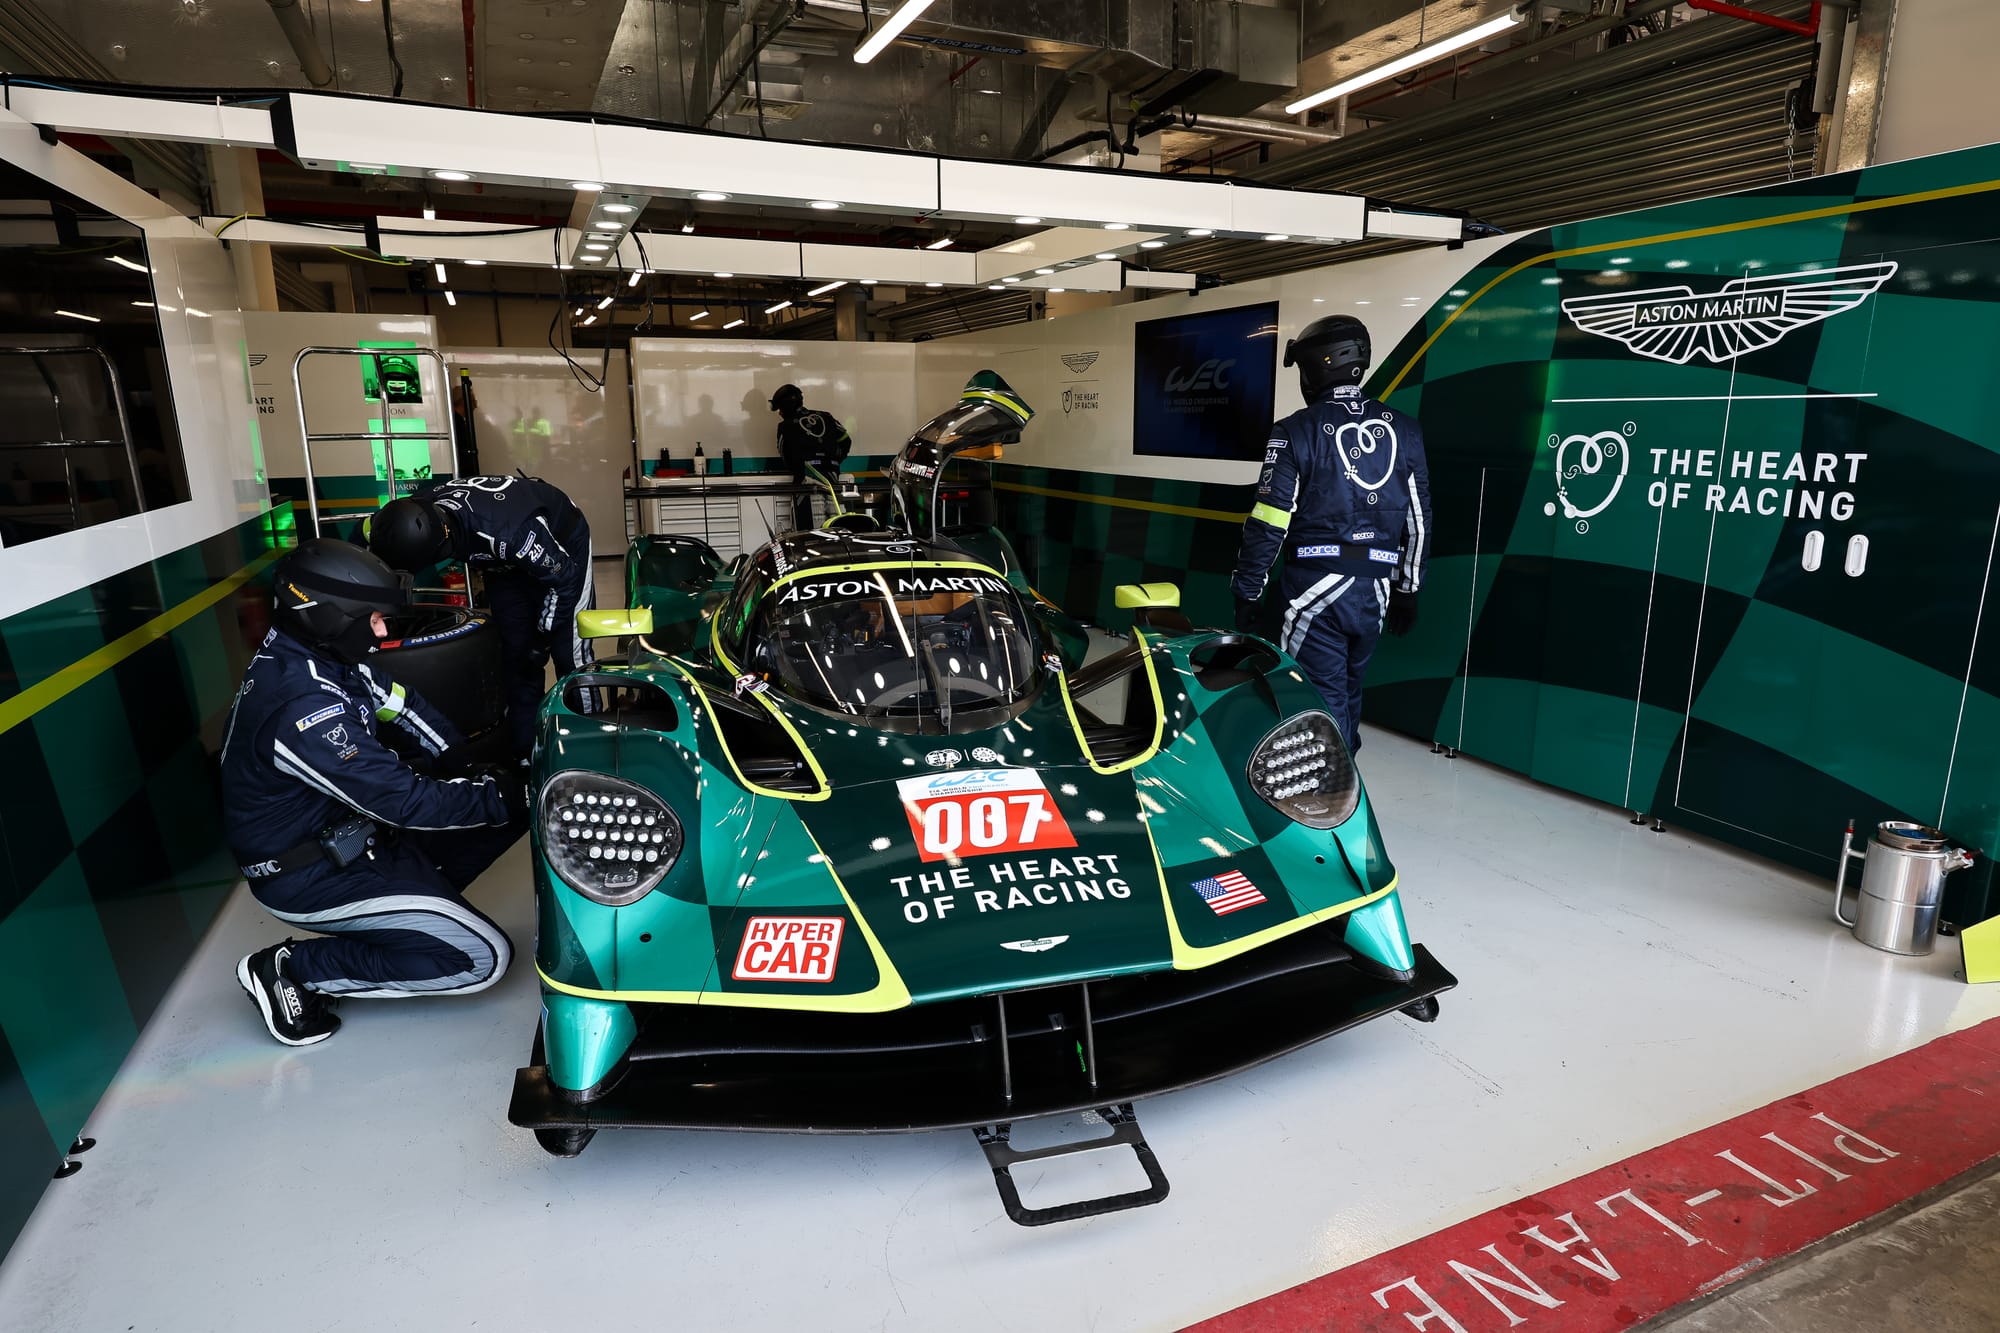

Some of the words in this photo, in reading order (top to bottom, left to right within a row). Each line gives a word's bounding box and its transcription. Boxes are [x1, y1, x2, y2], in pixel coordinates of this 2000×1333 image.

[1638, 303, 1698, 324] ASTON
[1702, 295, 1778, 319] MARTIN
[1164, 358, 1237, 392] WEC
[391, 408, 406, 416] OM
[1650, 448, 1716, 477] THE
[1730, 450, 1867, 483] HEART
[1648, 481, 1691, 508] OF
[1705, 484, 1855, 521] RACING
[1298, 545, 1340, 556] sparco
[1353, 532, 1374, 540] sparco
[1370, 549, 1399, 562] sparco
[778, 579, 887, 606] ASTON
[898, 577, 1010, 595] MARTIN
[411, 621, 479, 644] MICHELIN
[310, 707, 340, 722] MICHELIN
[928, 771, 1009, 788] WEC
[924, 794, 1045, 853] 007
[890, 868, 975, 898] THE
[989, 854, 1120, 883] HEART
[903, 895, 956, 924] OF
[974, 878, 1132, 913] RACING
[750, 922, 835, 941] HYPER
[743, 941, 830, 974] CAR
[1370, 1111, 1900, 1333] PIT-LANE
